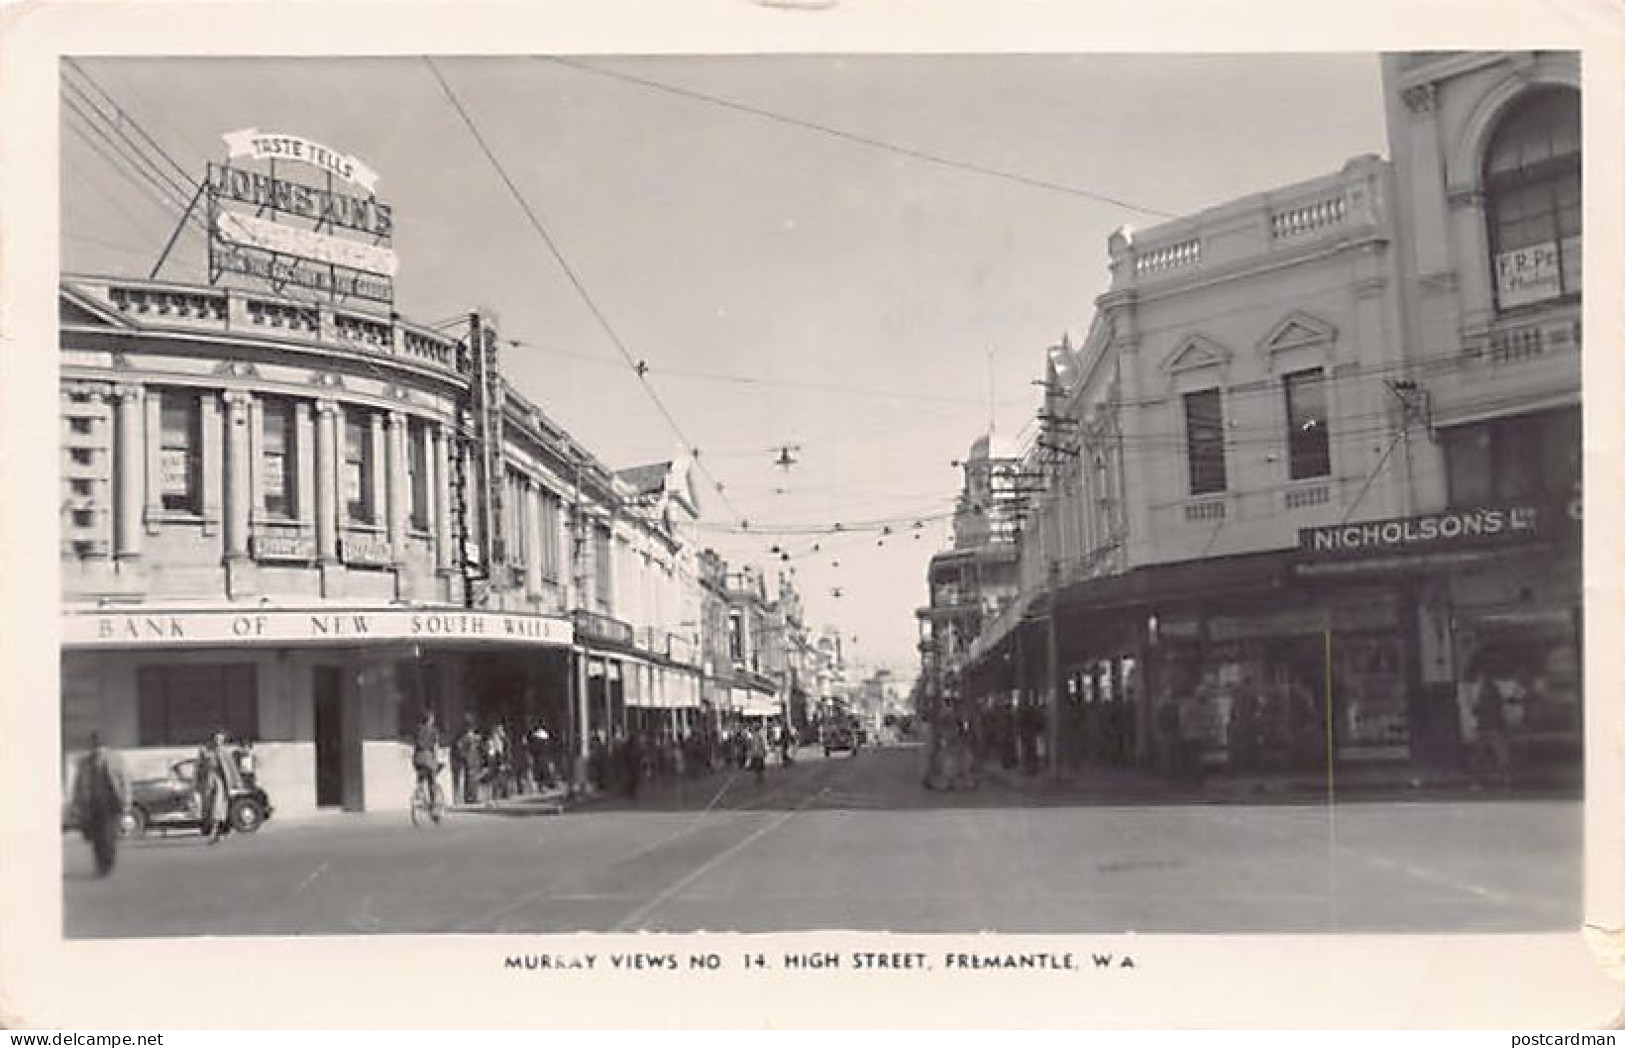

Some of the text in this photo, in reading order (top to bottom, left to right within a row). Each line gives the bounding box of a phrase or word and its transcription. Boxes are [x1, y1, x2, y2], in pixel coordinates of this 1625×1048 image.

[252, 138, 354, 178] TASTE TELLS
[219, 165, 392, 234] JOHNSTON'S
[1315, 508, 1504, 550] NICHOLSON'S
[98, 615, 551, 638] BANK OF NEW SOUTH WALES
